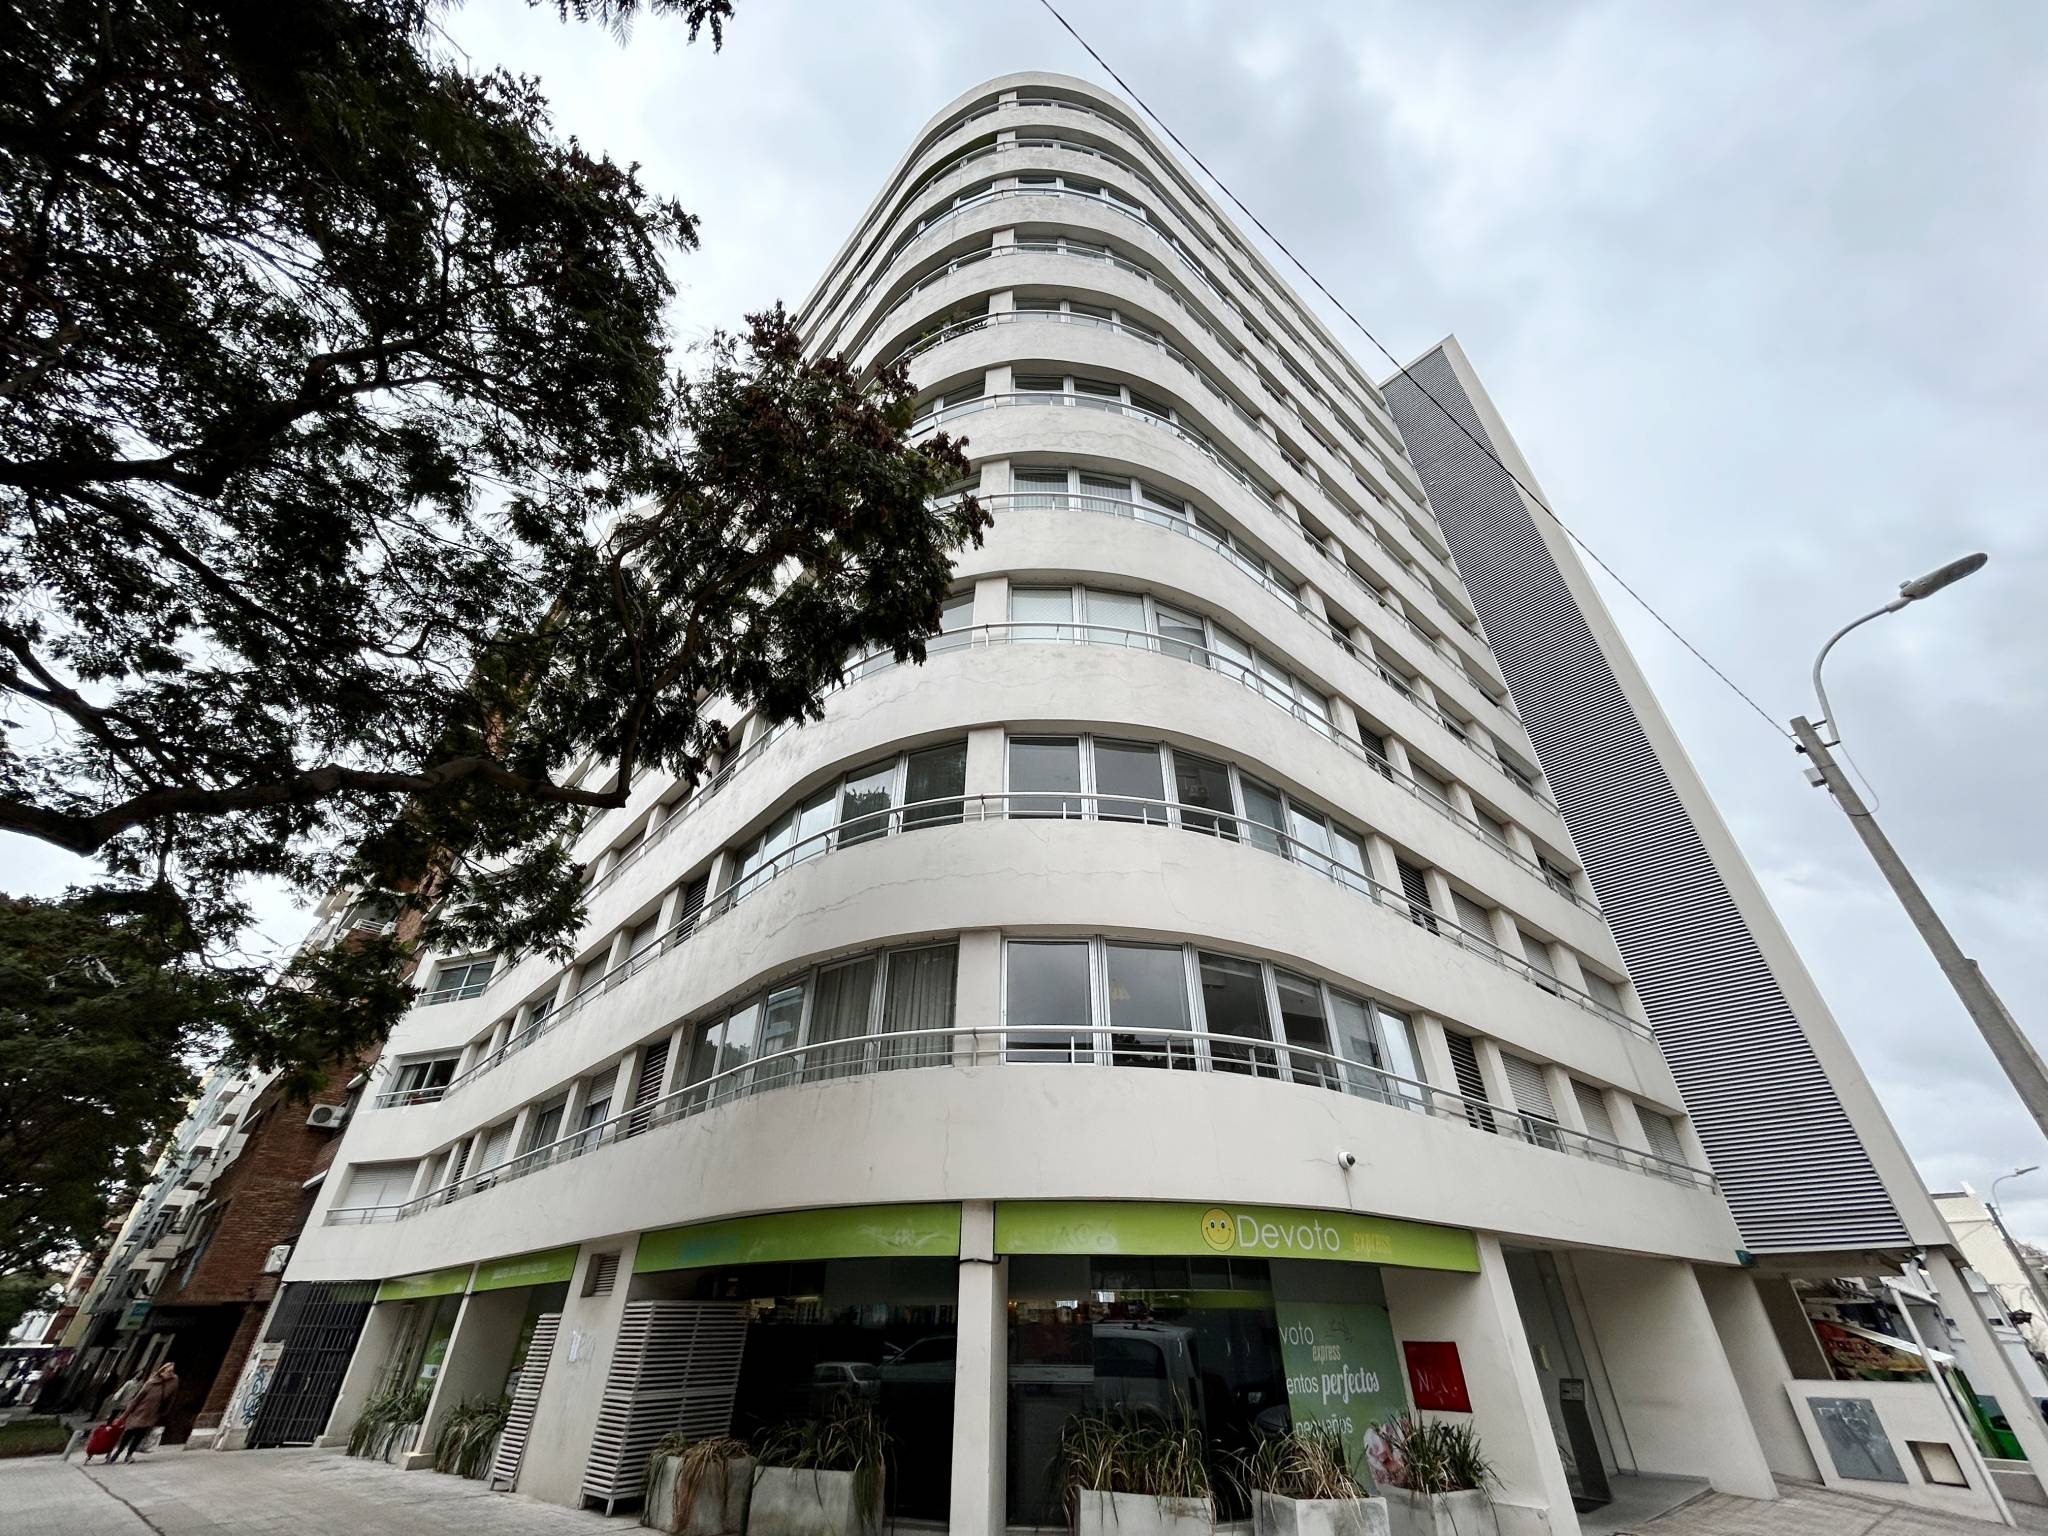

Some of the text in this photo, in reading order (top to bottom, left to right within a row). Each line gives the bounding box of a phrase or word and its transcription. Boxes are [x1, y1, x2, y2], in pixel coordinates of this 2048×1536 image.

[1236, 1214, 1392, 1258] Devoto express
[1279, 1321, 1314, 1345] voto
[1312, 1344, 1341, 1365] express
[1286, 1374, 1319, 1395] entos
[1321, 1363, 1380, 1406] perfectos
